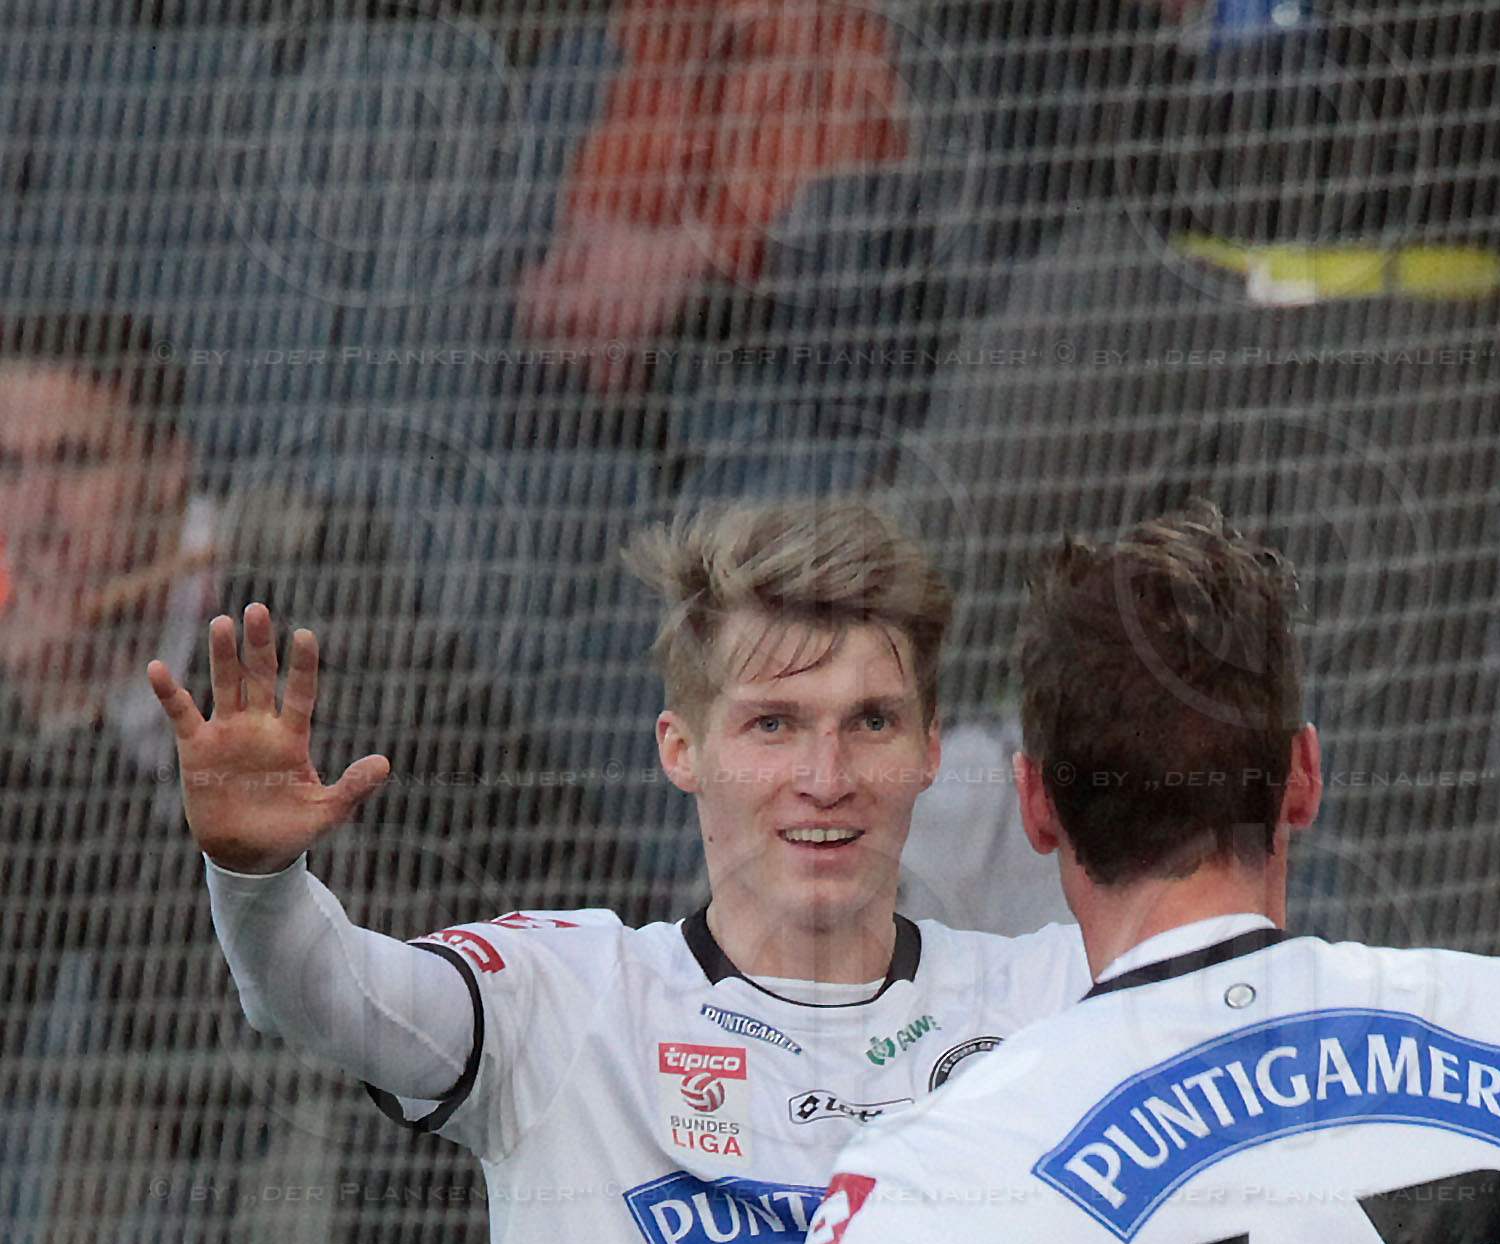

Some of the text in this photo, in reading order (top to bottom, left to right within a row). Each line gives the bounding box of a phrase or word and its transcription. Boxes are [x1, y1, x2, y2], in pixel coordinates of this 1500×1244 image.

[664, 1047, 741, 1072] tipico
[670, 1115, 740, 1135] BUNDES
[672, 1128, 743, 1157] LIGA
